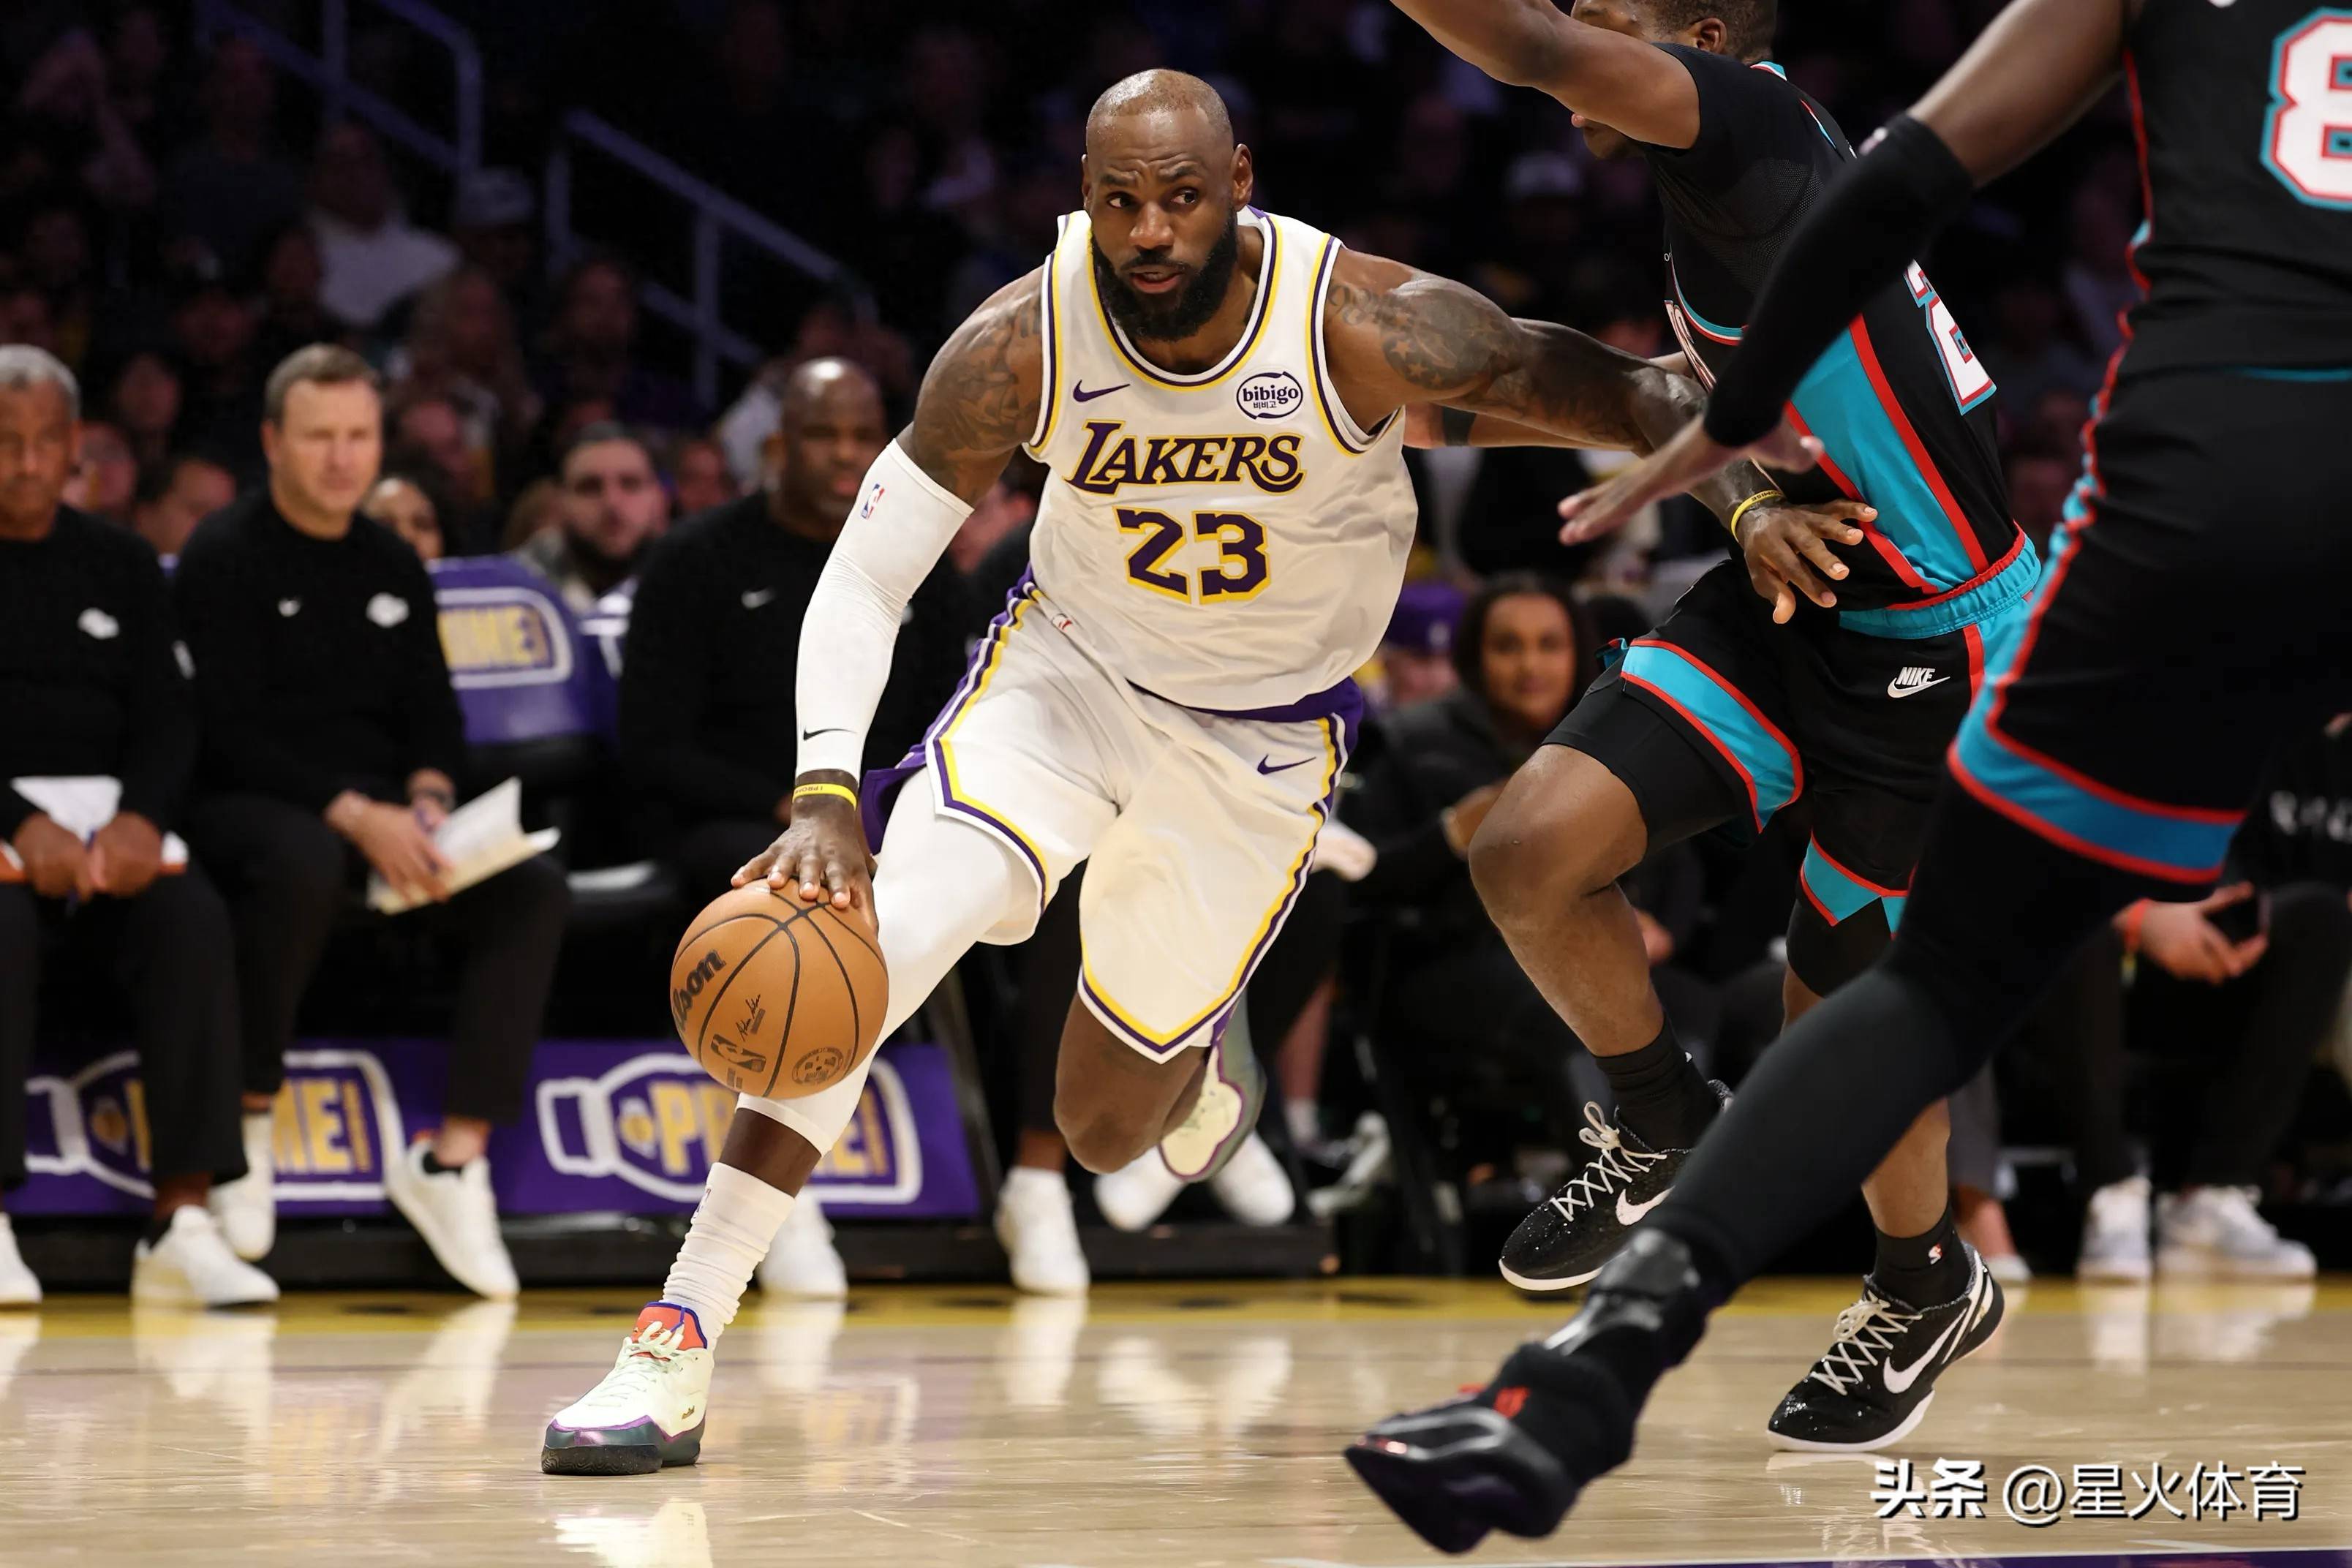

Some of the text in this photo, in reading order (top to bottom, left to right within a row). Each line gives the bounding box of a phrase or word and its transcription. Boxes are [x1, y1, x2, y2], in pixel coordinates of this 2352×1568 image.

[2259, 7, 2352, 211] 8
[1243, 385, 1298, 404] bibigo
[1253, 401, 1277, 410] 비비고
[1064, 420, 1307, 497] LAKERS
[1113, 506, 1272, 605] 23
[1895, 667, 1936, 686] NIKE
[673, 950, 726, 1033] lson
